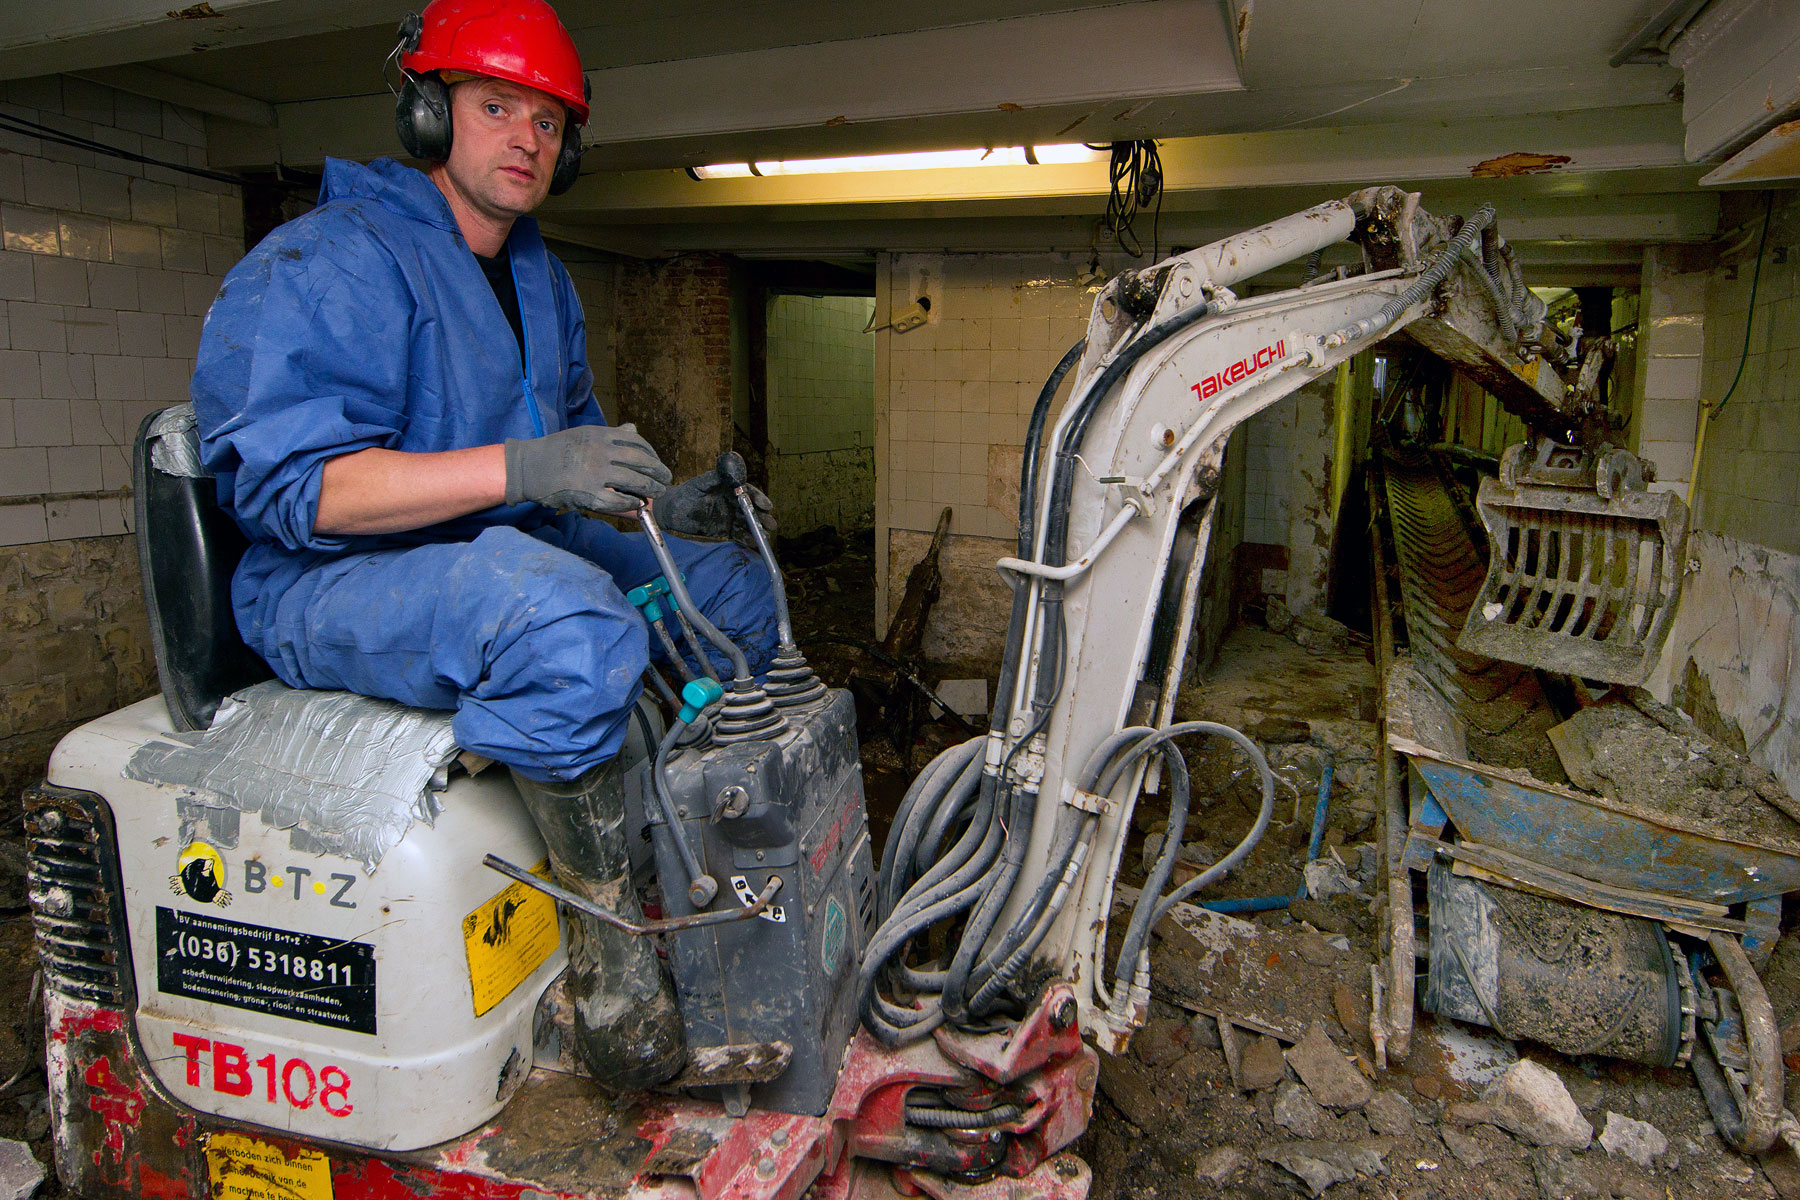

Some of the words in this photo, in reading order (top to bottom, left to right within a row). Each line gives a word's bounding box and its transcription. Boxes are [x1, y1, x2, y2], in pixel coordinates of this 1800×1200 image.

[1191, 339, 1285, 402] TAKEUCHI
[179, 915, 190, 925] BV
[192, 919, 272, 941] aannemingsbedrijf
[178, 931, 238, 967] (036)
[248, 947, 352, 987] 5318811
[295, 1006, 306, 1014] en
[307, 1008, 351, 1023] straatwerk
[172, 1032, 354, 1118] TB108
[264, 1154, 282, 1165] zich
[278, 1176, 294, 1185] van
[296, 1178, 307, 1188] de
